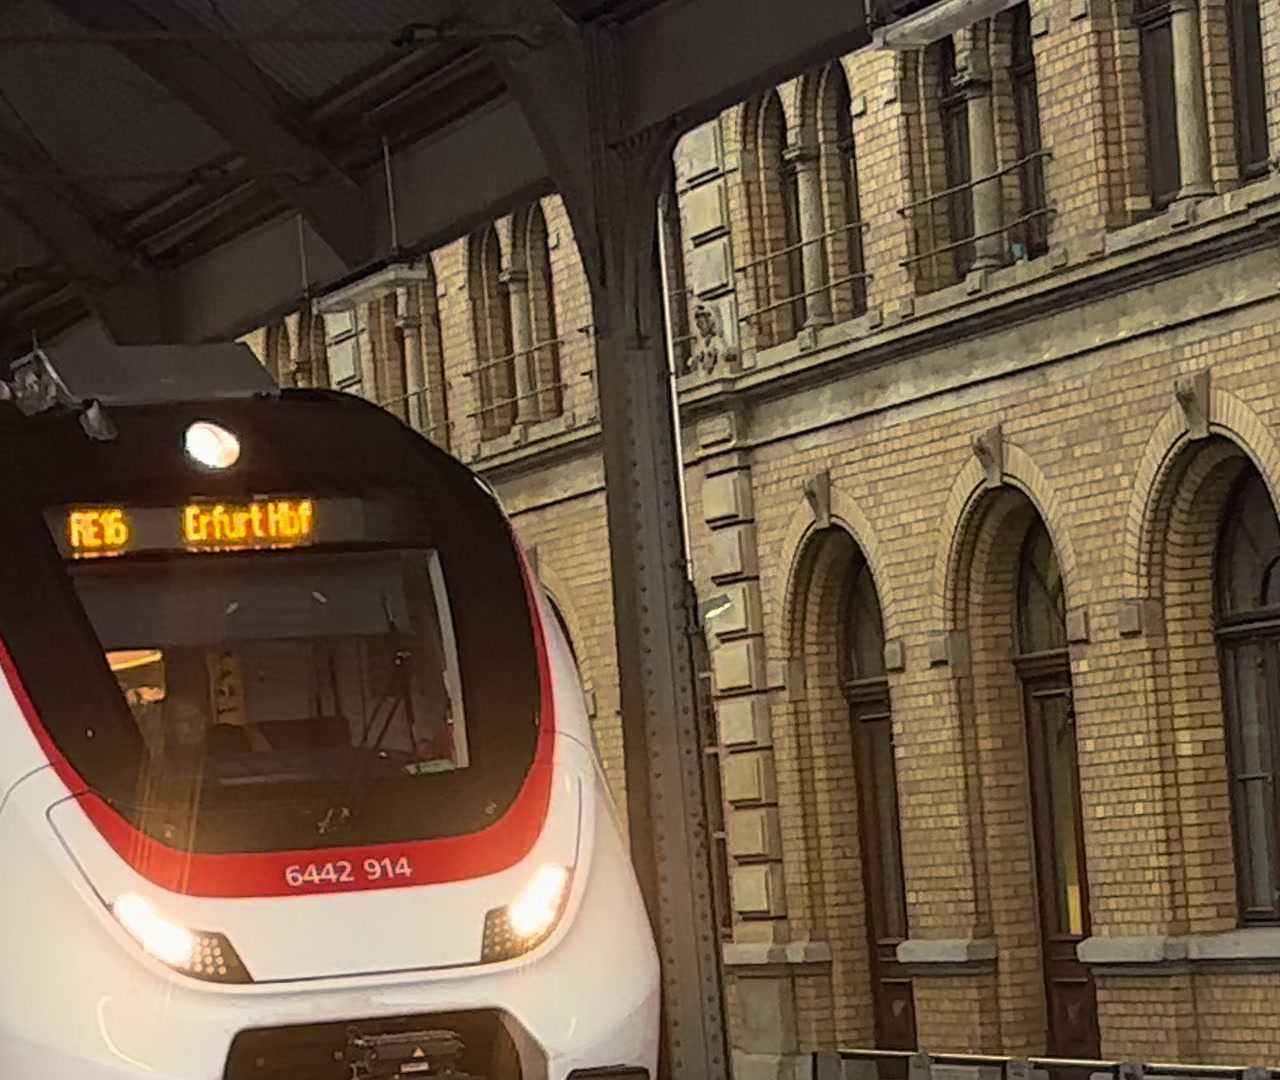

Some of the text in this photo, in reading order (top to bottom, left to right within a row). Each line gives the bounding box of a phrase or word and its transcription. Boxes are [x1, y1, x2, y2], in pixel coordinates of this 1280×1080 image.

[70, 499, 313, 548] RE16 Erfurt Hbf
[285, 856, 414, 888] 6442 914
